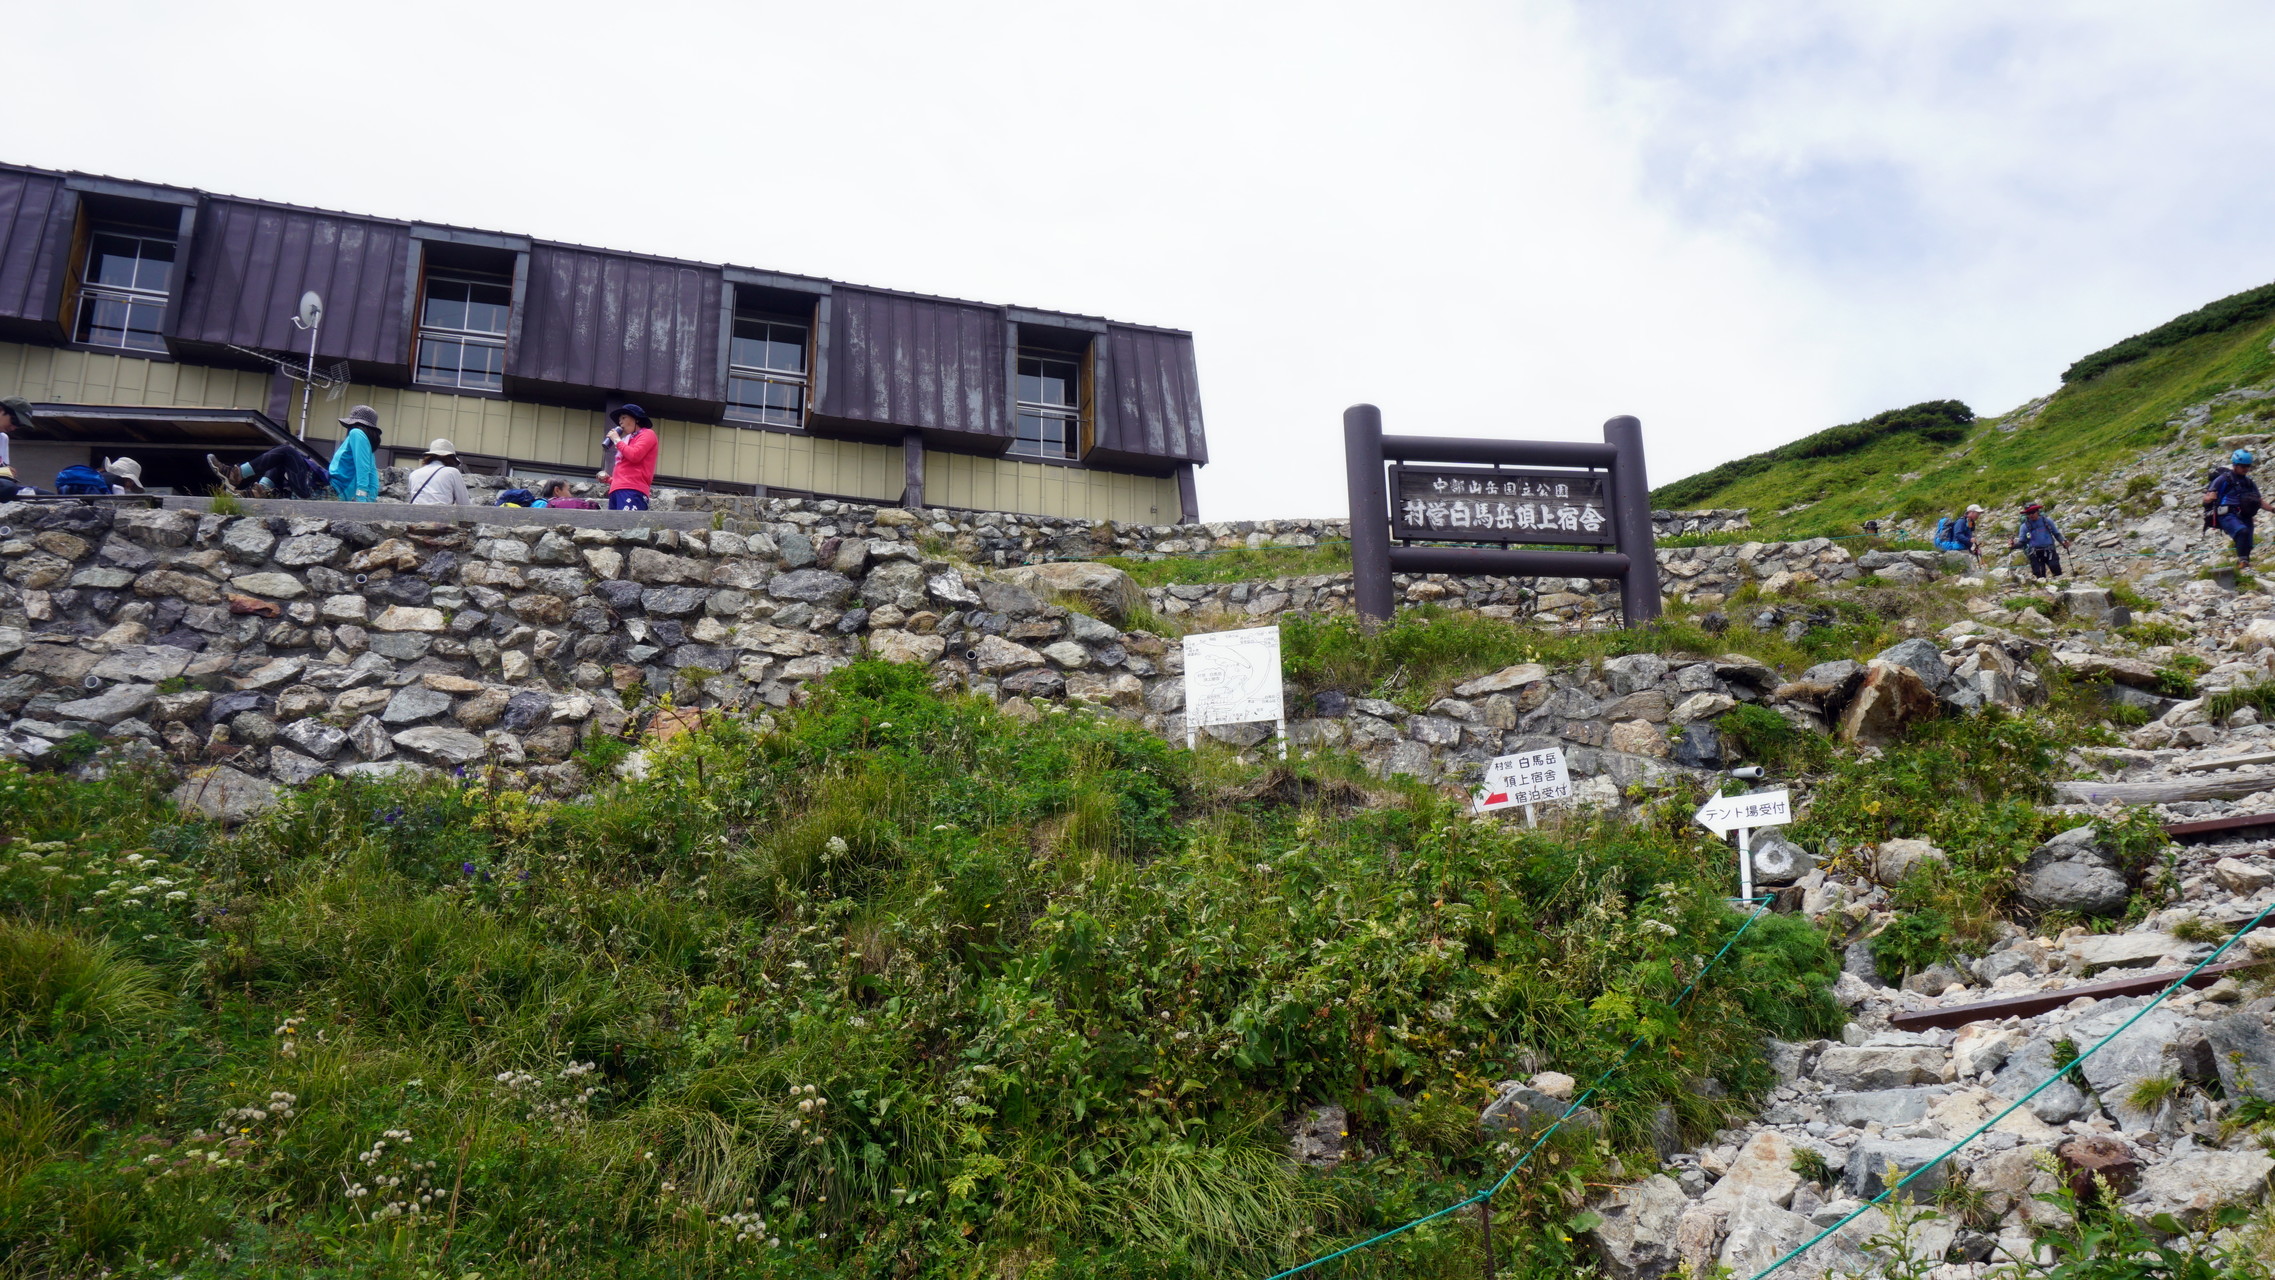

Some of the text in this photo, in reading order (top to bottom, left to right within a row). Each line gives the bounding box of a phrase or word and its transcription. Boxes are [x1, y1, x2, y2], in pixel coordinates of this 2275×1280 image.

[1433, 477, 1569, 498] 中部山岳国立公園
[1403, 499, 1606, 532] 村営白馬岳頂上宿舎
[1494, 752, 1557, 771] 村営 白馬岳
[1505, 769, 1556, 788] 頂上宿舎
[1515, 783, 1567, 804] 宿泊受付
[1706, 802, 1785, 821] テント場受付
